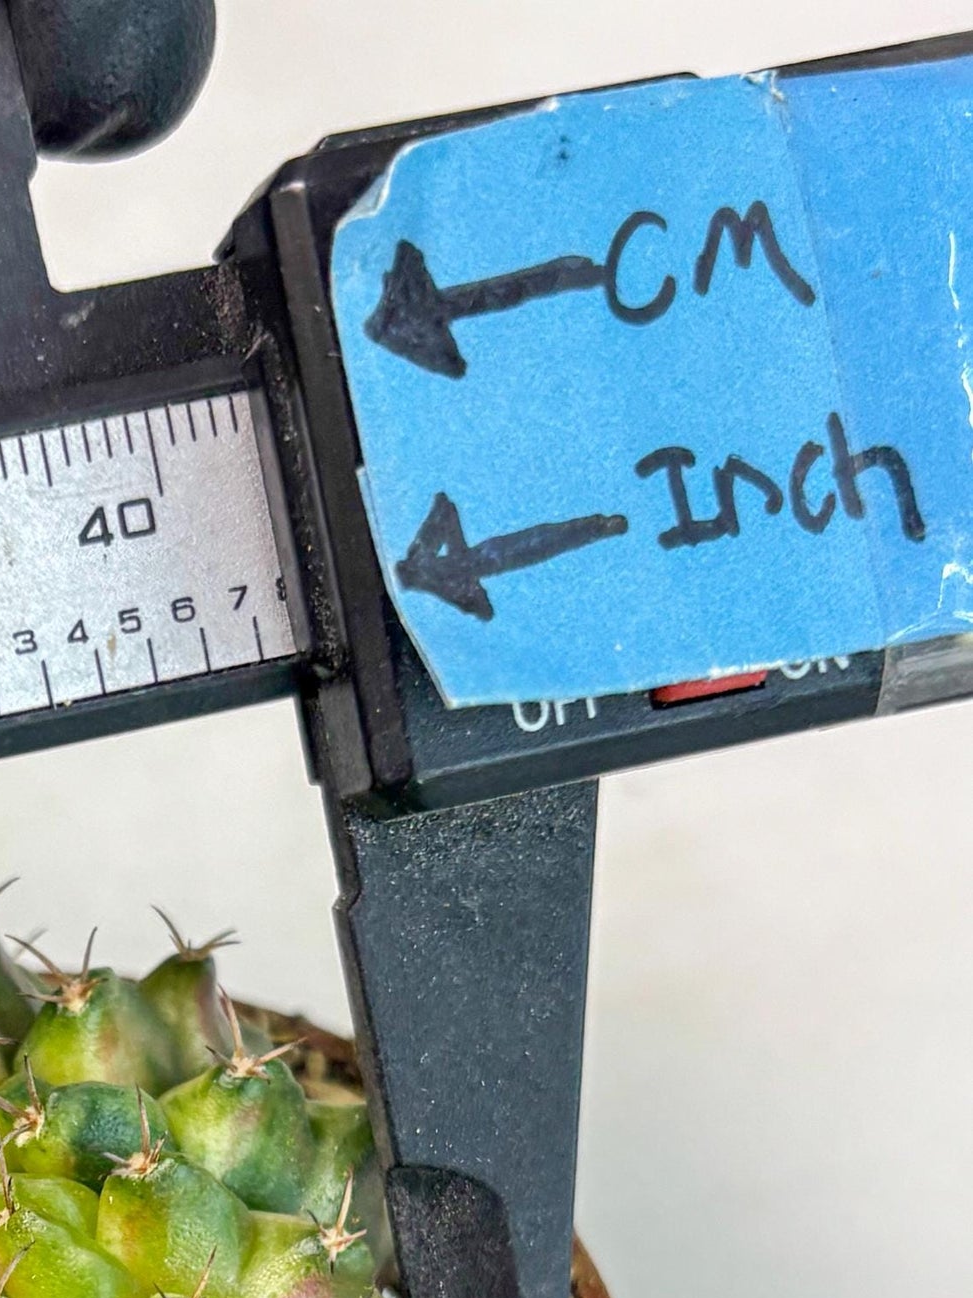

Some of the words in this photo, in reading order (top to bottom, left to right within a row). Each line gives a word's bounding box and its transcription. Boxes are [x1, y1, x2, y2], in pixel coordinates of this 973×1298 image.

[635, 412, 925, 550] Inch
[78, 497, 156, 547] 40
[13, 630, 38, 655] 3
[67, 619, 89, 645] 4
[118, 608, 143, 634] 5
[171, 596, 196, 623] 6
[228, 585, 247, 611] 7
